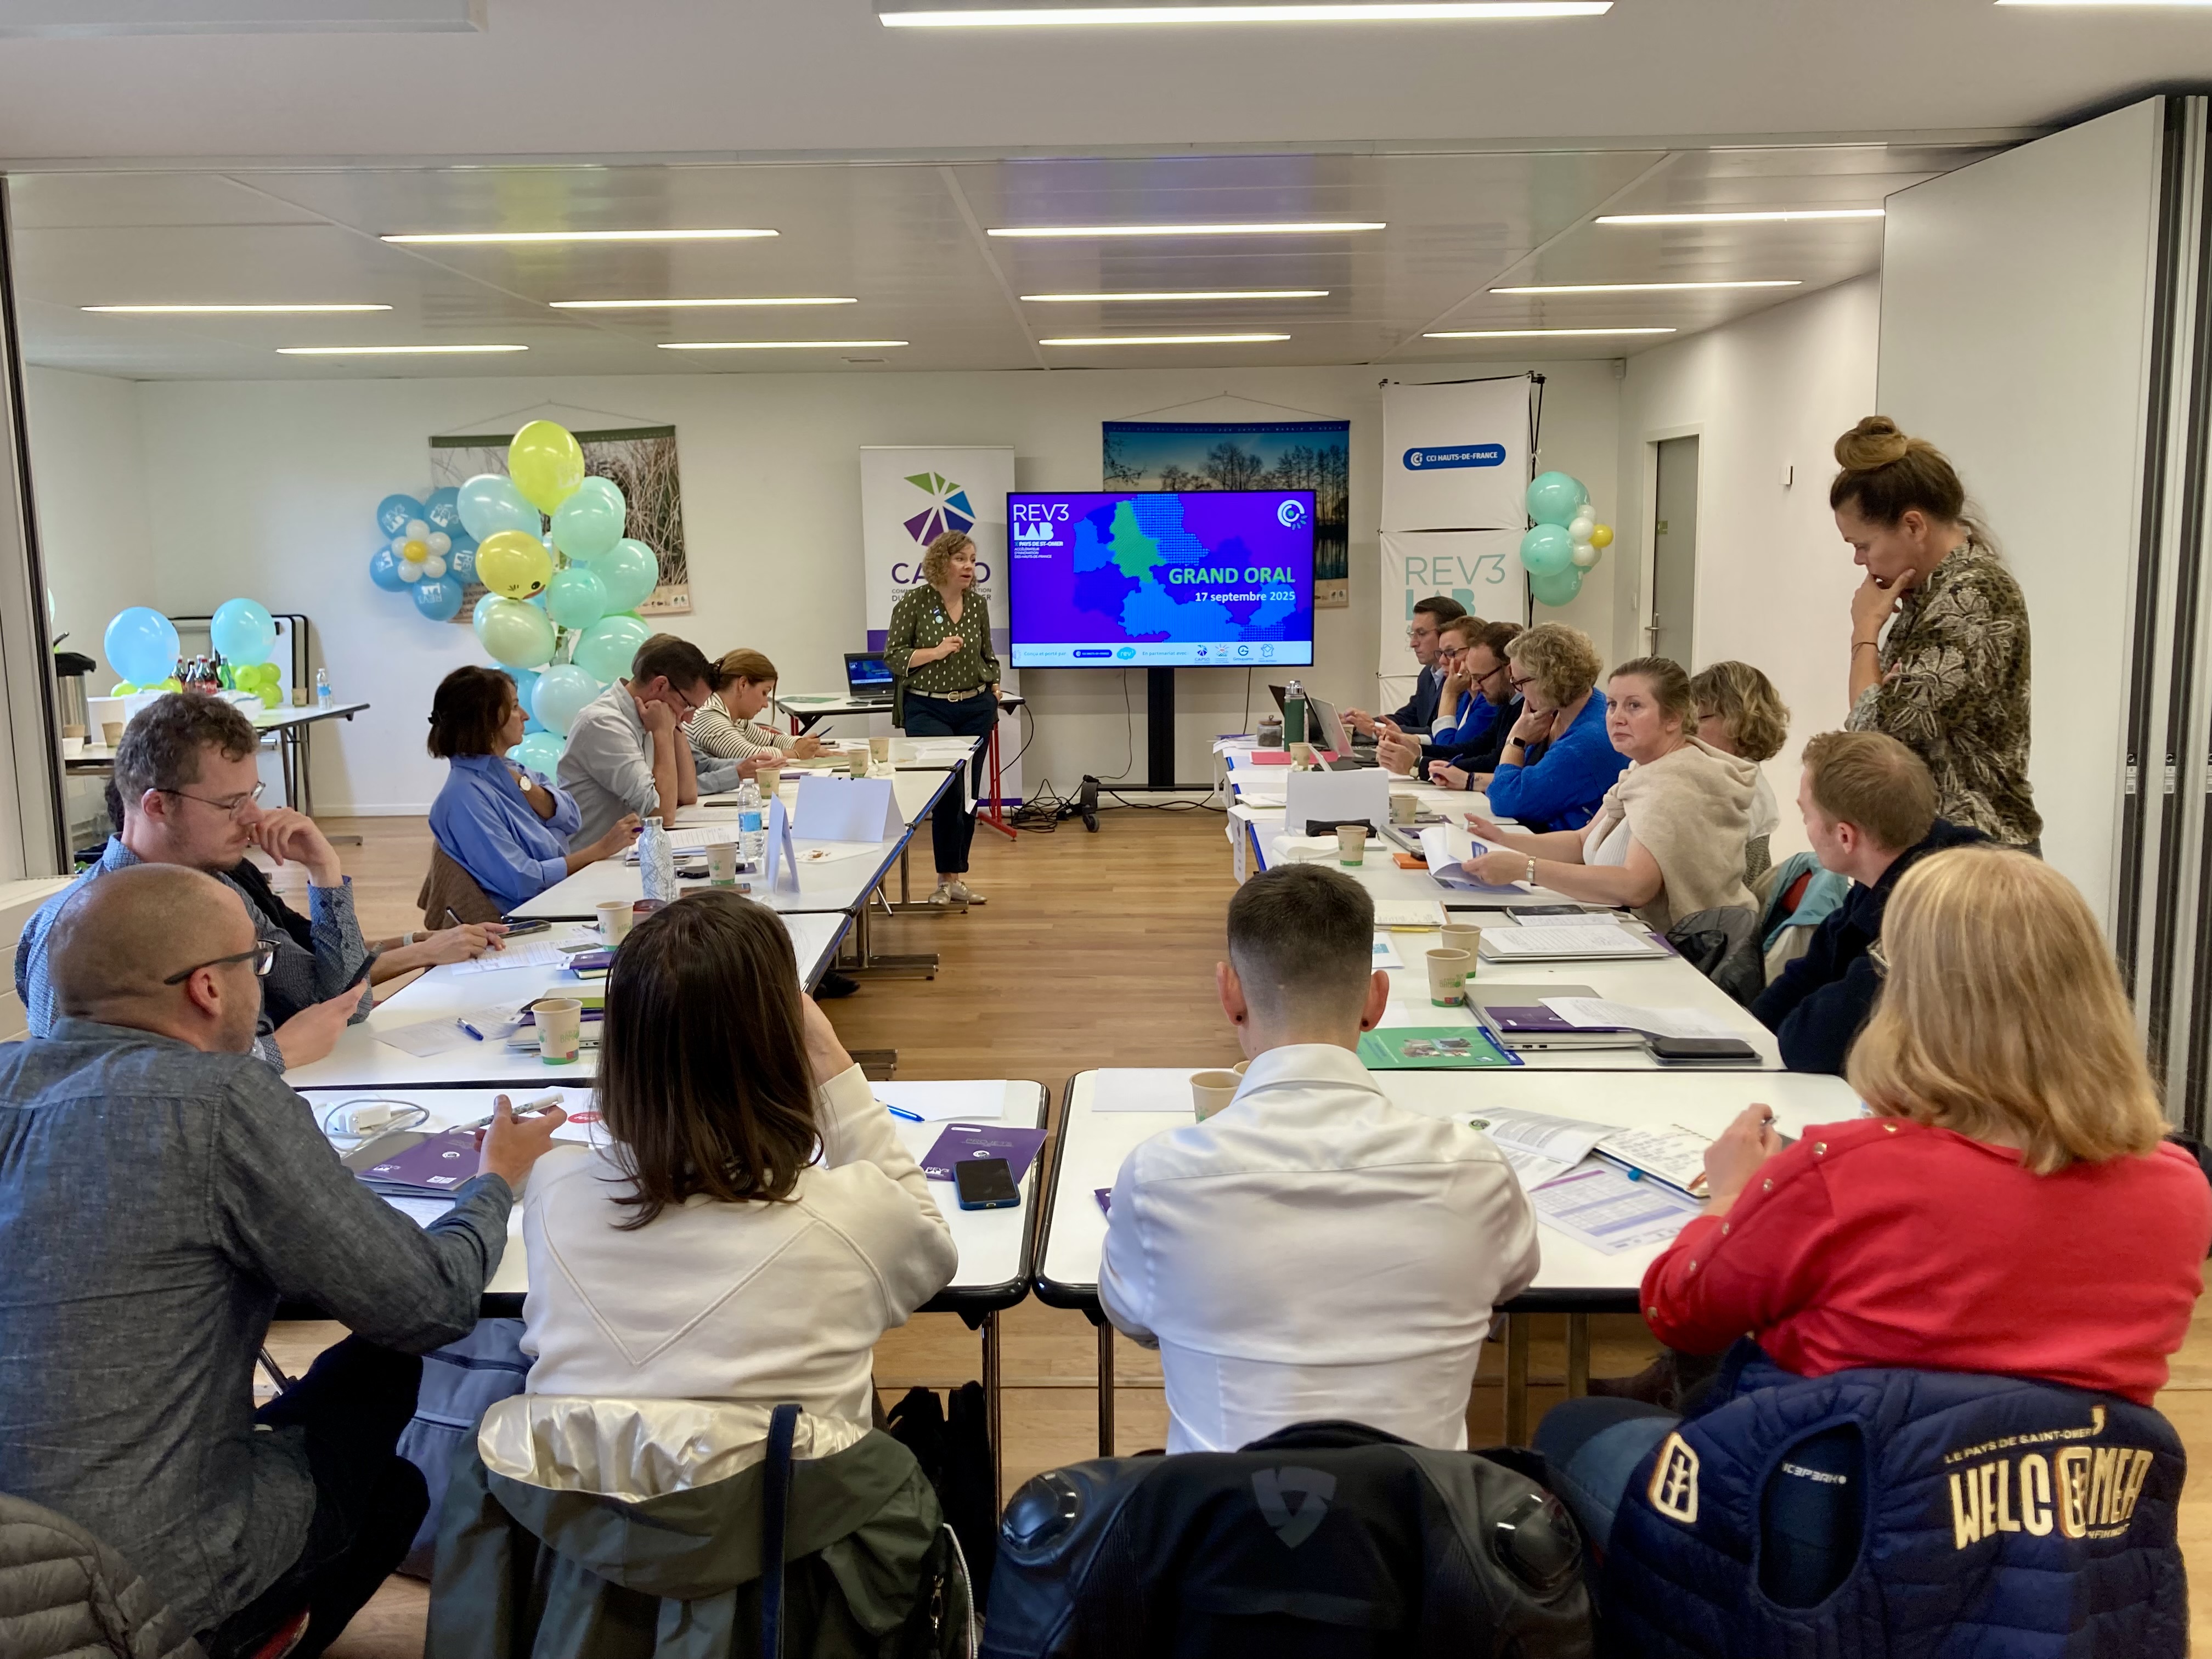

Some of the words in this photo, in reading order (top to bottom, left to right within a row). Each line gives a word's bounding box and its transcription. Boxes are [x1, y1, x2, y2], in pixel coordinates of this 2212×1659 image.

[1438, 452, 1498, 461] HAUTS-DE-FRANCE
[1013, 504, 1069, 521] REV3
[1013, 522, 1054, 541] LAB
[891, 562, 991, 584] CAO
[1169, 567, 1239, 584] GRAND
[1244, 567, 1296, 584] ORAL
[1405, 554, 1506, 585] REV3
[1195, 592, 1208, 602] 17
[1210, 591, 1267, 603] septembre
[1269, 591, 1295, 601] 2025
[1406, 588, 1476, 620] LB
[1944, 1451, 1963, 1464] LE
[1963, 1441, 1997, 1459] PAYS
[1998, 1436, 2018, 1448] DE
[2019, 1427, 2092, 1444] SAINT-OMER
